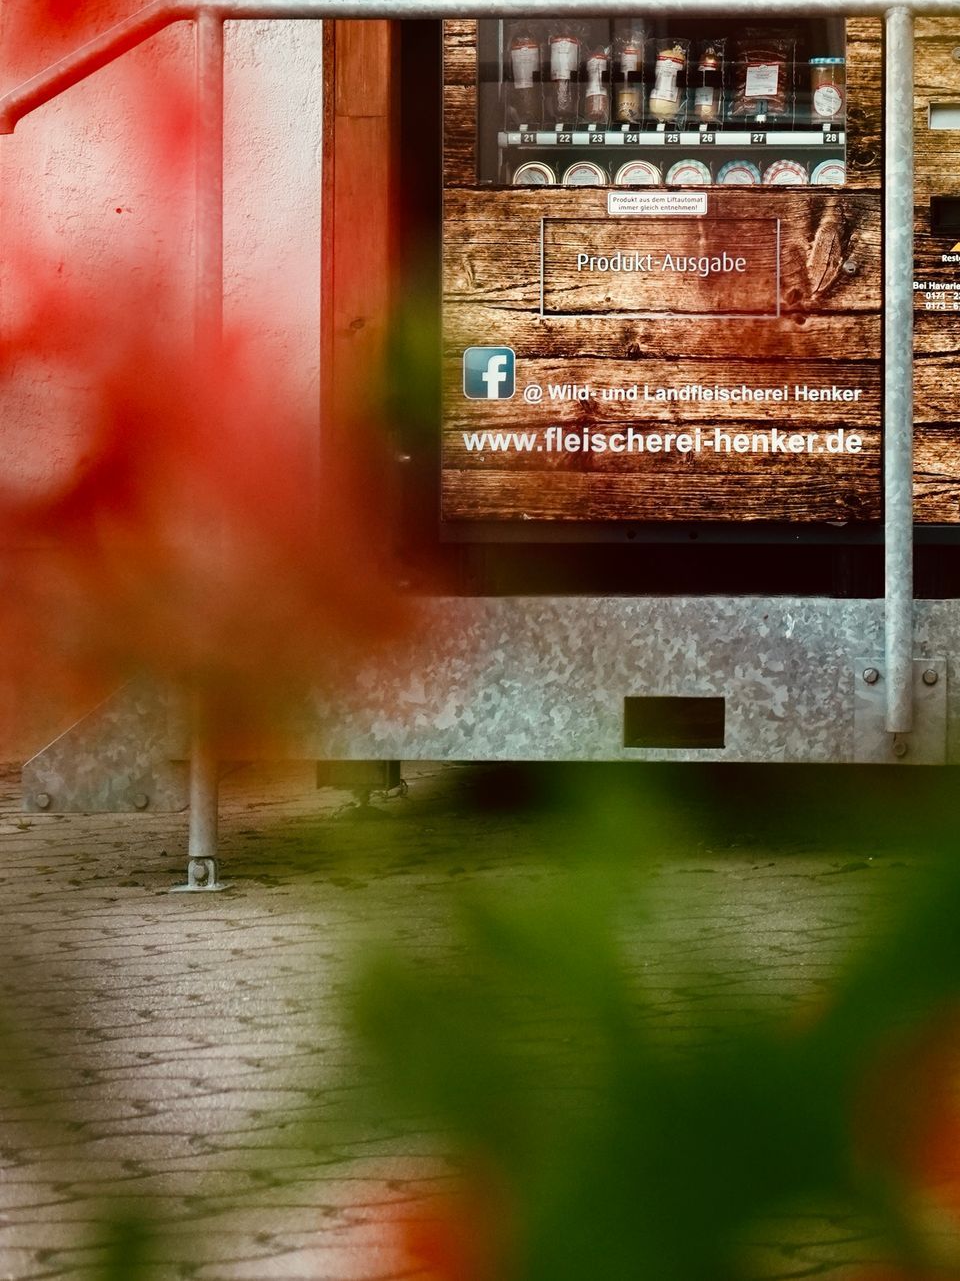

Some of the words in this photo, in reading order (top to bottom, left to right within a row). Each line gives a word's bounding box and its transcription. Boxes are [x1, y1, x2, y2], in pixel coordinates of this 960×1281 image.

[524, 134, 534, 142] 21
[559, 134, 570, 142] 22
[592, 134, 603, 142] 23
[627, 134, 637, 142] 24
[668, 134, 678, 142] 25
[702, 134, 713, 142] 26
[753, 134, 764, 142] 27
[826, 134, 836, 142] 28
[577, 252, 747, 277] Produkt-Ausgabe
[523, 384, 543, 403] @
[548, 384, 597, 401] Wild-
[602, 385, 637, 401] und
[644, 385, 788, 401] Landfleischerei
[795, 386, 861, 401] Henker
[463, 427, 863, 453] www.fleischerei-henker.de
